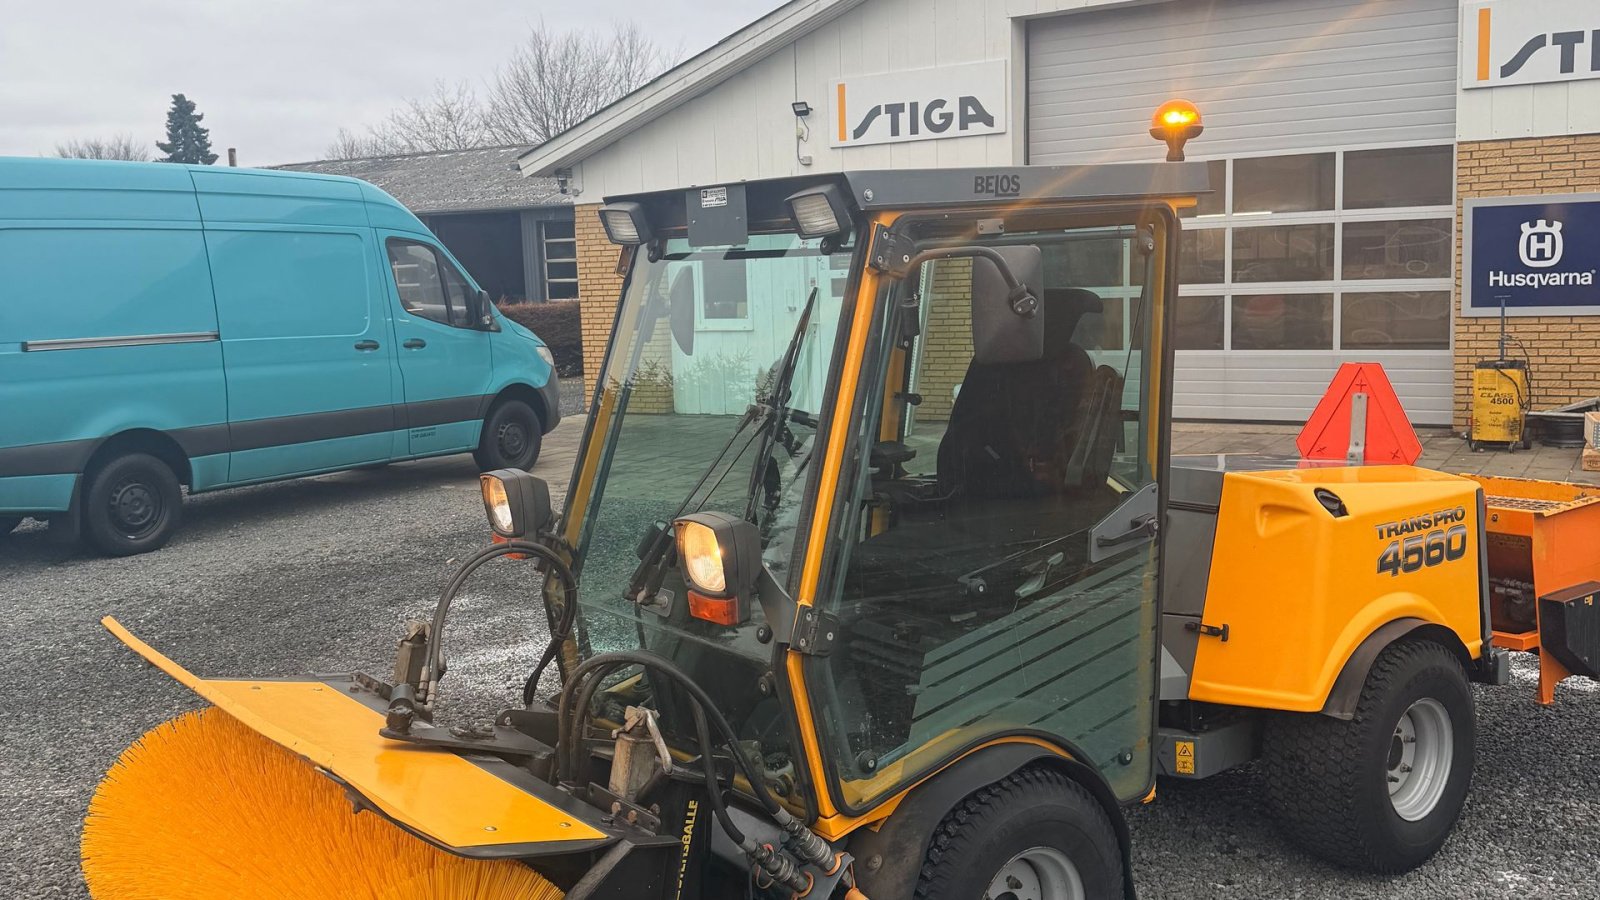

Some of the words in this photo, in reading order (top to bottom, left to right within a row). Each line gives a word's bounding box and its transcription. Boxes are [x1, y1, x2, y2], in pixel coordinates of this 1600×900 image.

[853, 95, 994, 140] STIGA
[974, 174, 1021, 197] BELOS
[1489, 270, 1593, 289] Husqvarna
[1377, 524, 1467, 577] 4560
